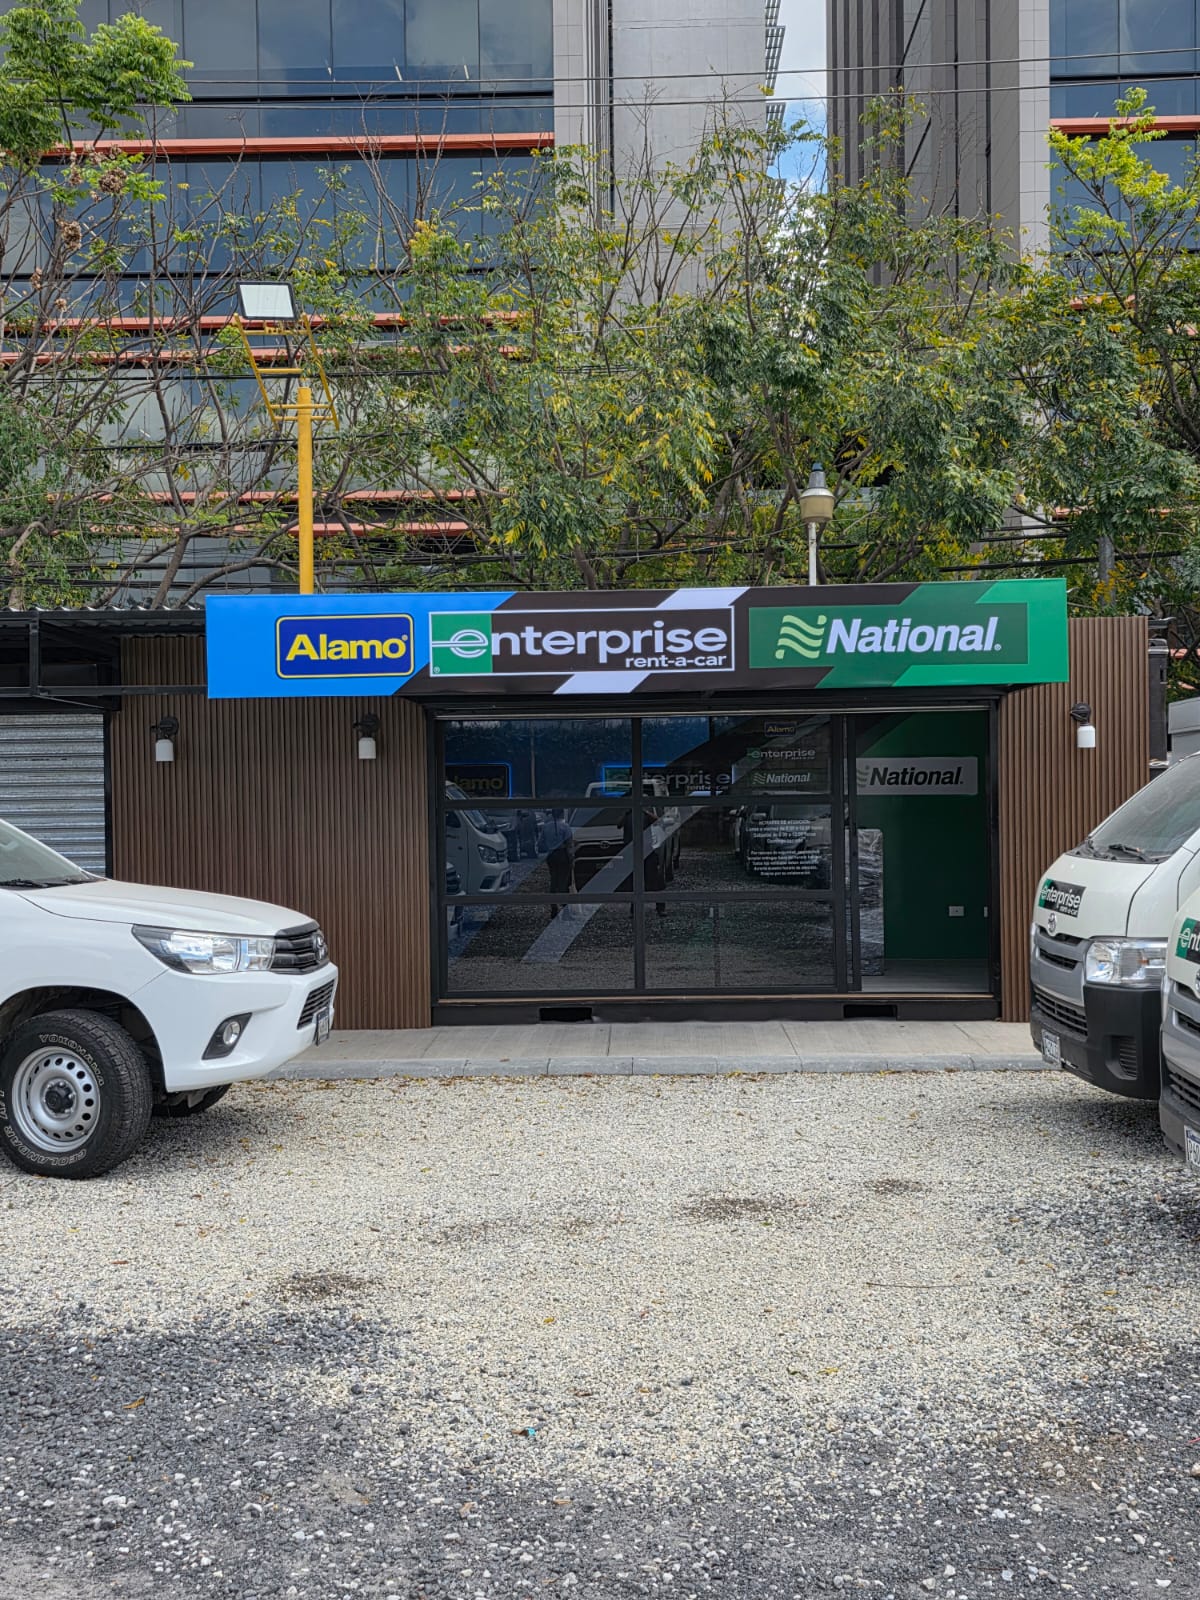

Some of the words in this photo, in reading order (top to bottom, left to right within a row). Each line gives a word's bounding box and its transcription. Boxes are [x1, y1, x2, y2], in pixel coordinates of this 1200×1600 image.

[285, 633, 406, 661] Alamo
[449, 620, 728, 664] enterprise
[826, 616, 998, 654] National
[625, 653, 727, 668] rent-a-car
[751, 748, 816, 760] enterprise
[766, 773, 811, 784] National
[869, 765, 963, 786] National
[1040, 884, 1081, 909] enterprise
[38, 1033, 105, 1087] YOKOHAMA
[4, 1125, 87, 1166] GEOLANDAR
